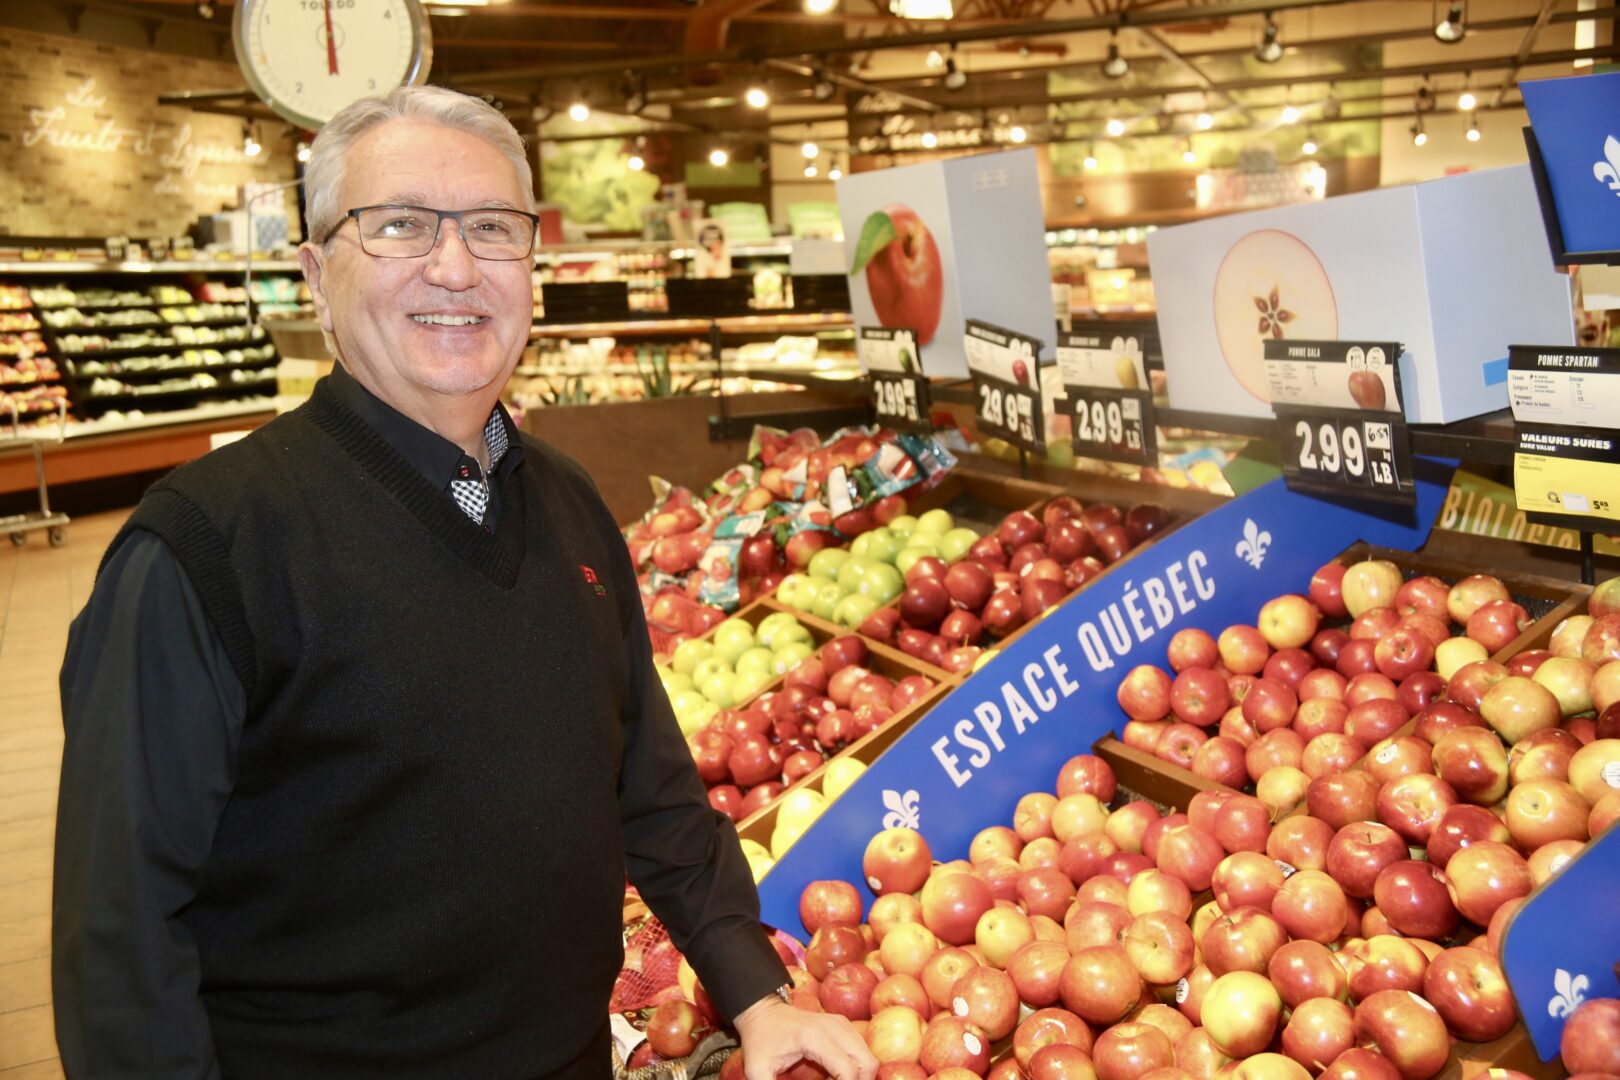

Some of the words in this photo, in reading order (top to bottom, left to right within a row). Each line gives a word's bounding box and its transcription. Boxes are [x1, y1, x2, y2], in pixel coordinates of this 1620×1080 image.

[301, 0, 356, 10] TOLEDO
[384, 9, 392, 20] 4
[296, 82, 303, 93] 2
[369, 79, 376, 90] 3
[1307, 347, 1321, 358] GALA
[1537, 354, 1563, 367] POMME
[1565, 356, 1599, 368] SPARTAN
[1521, 433, 1570, 446] VALEURS
[1295, 420, 1364, 477] 2.99
[1519, 442, 1536, 450] SURE
[1536, 444, 1556, 452] VALUE
[1371, 461, 1393, 484] LB
[931, 644, 1080, 788] ESPACE
[1077, 550, 1216, 672] QUÉBEC
